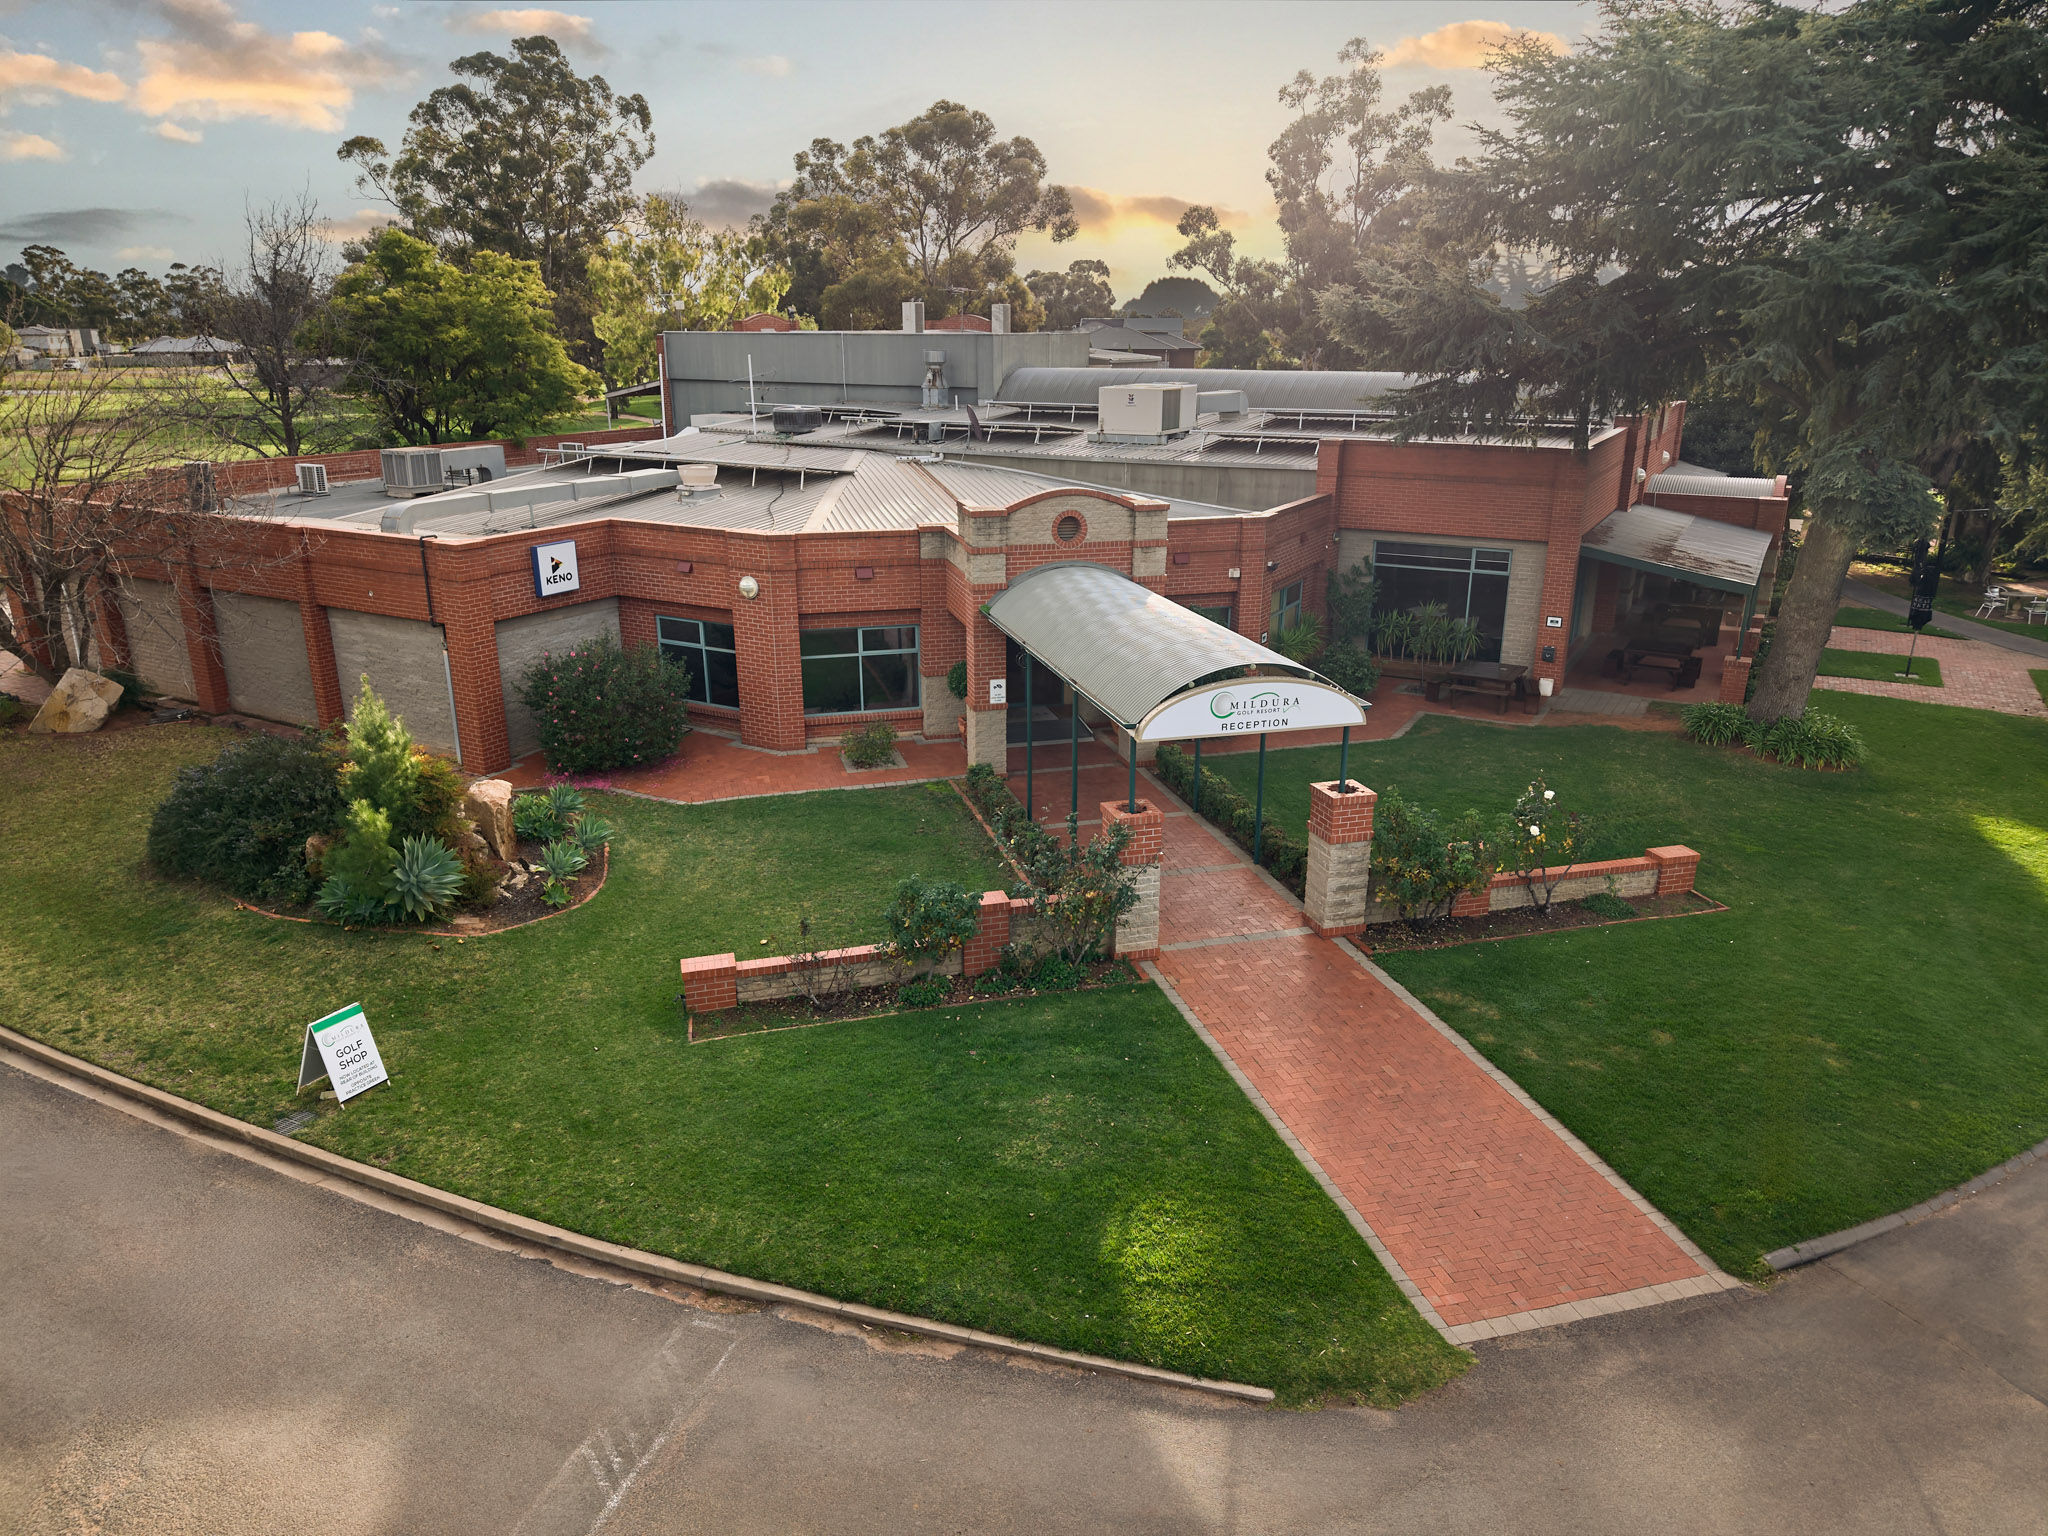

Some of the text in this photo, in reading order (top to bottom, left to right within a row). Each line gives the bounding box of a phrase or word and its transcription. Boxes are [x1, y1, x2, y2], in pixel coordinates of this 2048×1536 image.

[546, 572, 573, 585] KENO
[1230, 697, 1300, 711] MILDURA
[1221, 718, 1289, 731] RECEPTION
[335, 1039, 363, 1059] GOLF
[339, 1050, 368, 1070] SHOP
[351, 1063, 369, 1075] LOCATED
